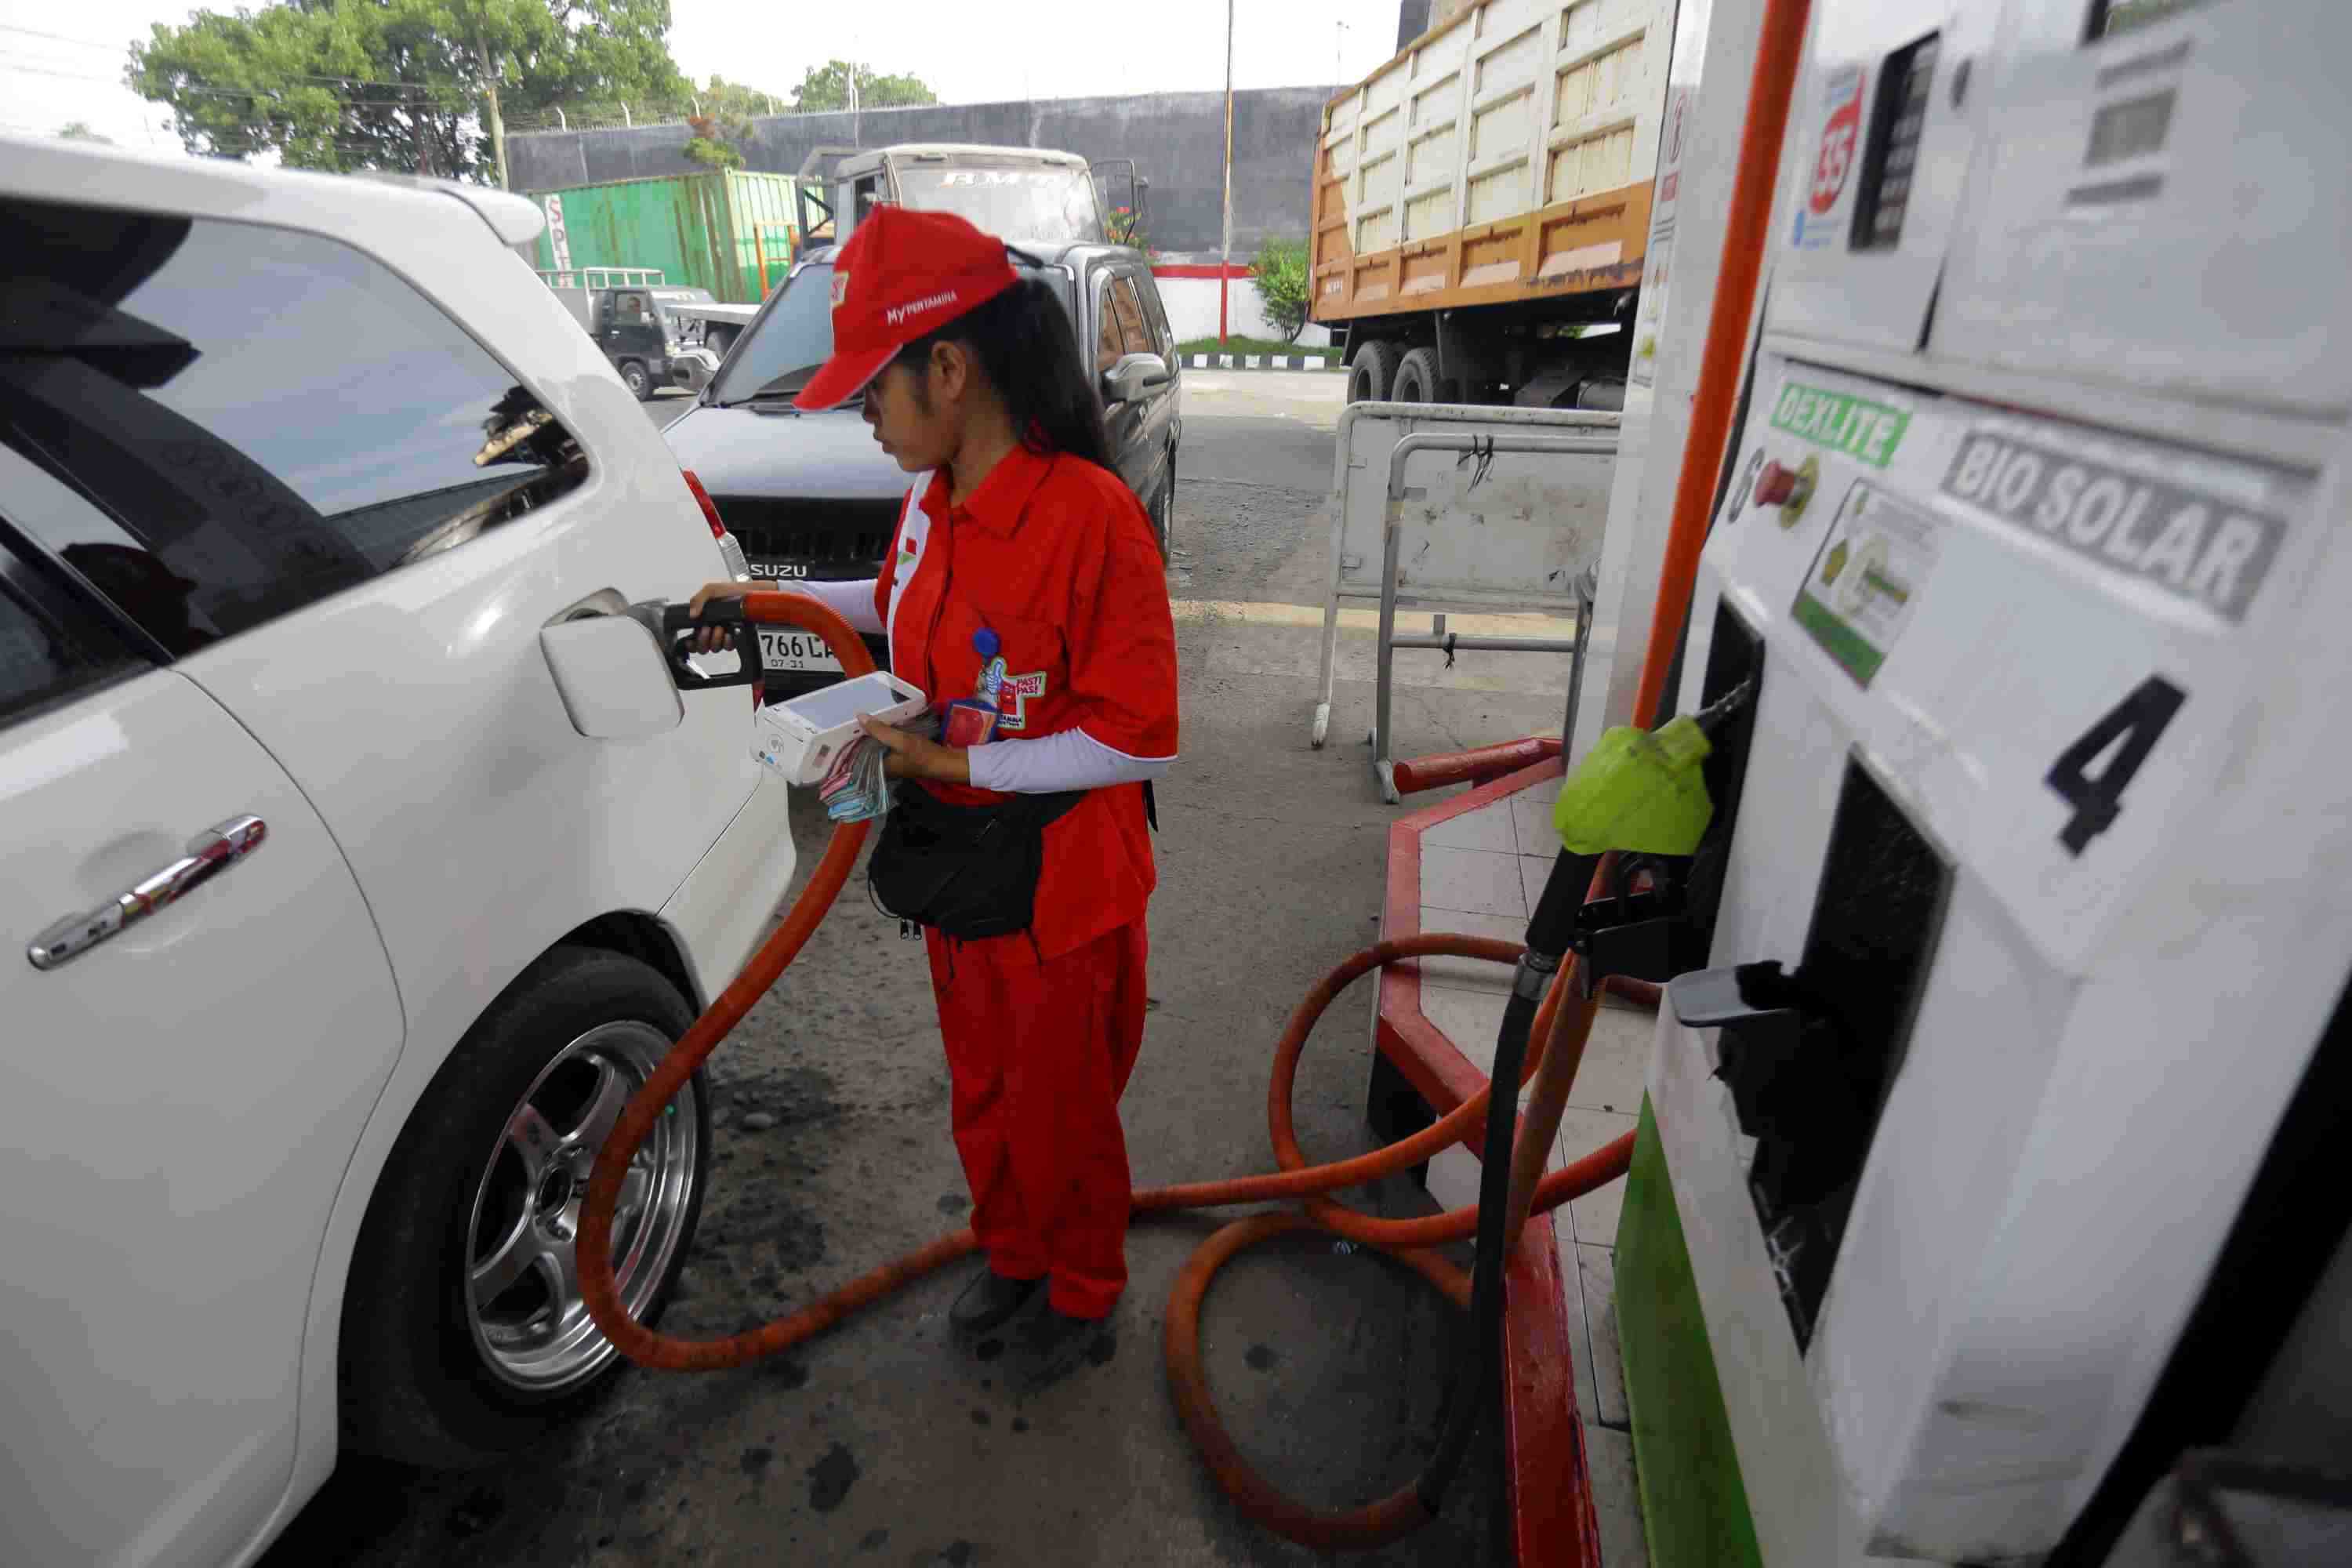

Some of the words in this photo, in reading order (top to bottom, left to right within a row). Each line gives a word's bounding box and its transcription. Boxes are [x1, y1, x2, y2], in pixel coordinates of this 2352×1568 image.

[1776, 383, 1901, 457] DEXLITE
[1955, 439, 2044, 511] BIO
[2036, 466, 2267, 607] SOLAR
[2043, 673, 2188, 860] 4
